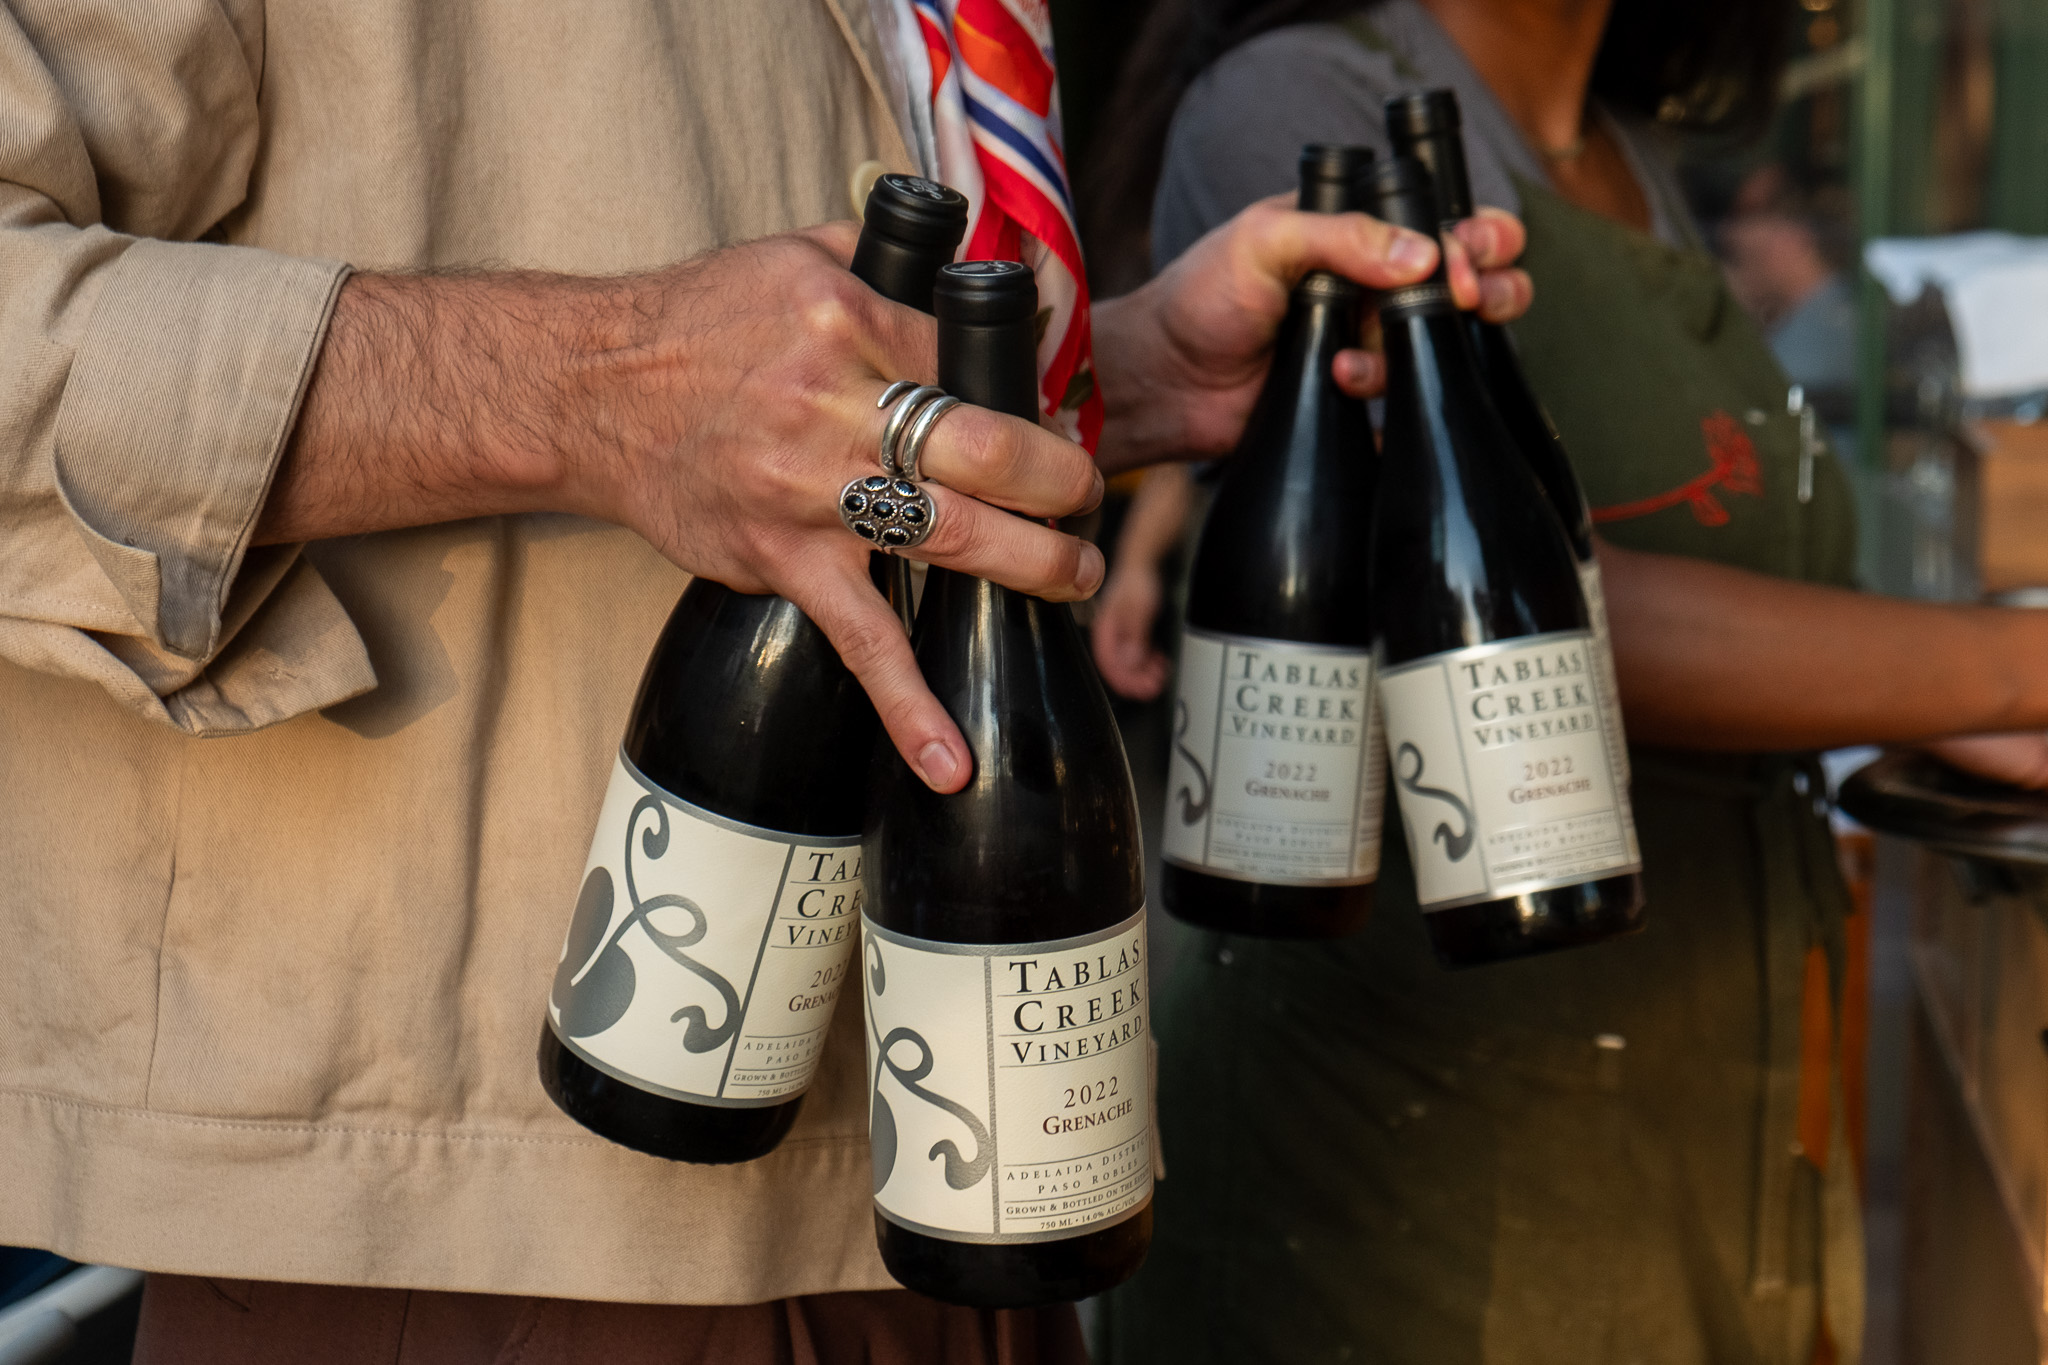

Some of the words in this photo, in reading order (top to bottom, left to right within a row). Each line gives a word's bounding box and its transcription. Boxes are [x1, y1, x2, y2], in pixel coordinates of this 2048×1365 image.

[1237, 652, 1360, 688] TABLAS
[1461, 651, 1582, 689] TABLAS
[1236, 685, 1355, 720] CREEK
[1471, 683, 1588, 721] CREEK
[1233, 716, 1356, 744] VINEYARD
[1474, 714, 1594, 747] VINEYARD
[1264, 761, 1318, 782] 2022
[1524, 756, 1574, 781] 2022
[1245, 780, 1330, 802] GRENACHE
[1508, 778, 1591, 804] GRENACHE
[1009, 939, 1140, 993] TABLAS
[1014, 979, 1141, 1032] CREEK
[744, 1038, 811, 1051] ADELAIDA
[1011, 1015, 1142, 1063] VINEYARD
[766, 1053, 799, 1065] PASO
[733, 1073, 768, 1082] GROWN
[1064, 1076, 1118, 1109] 2022
[1042, 1098, 1133, 1135] GRENACHE
[1007, 1162, 1093, 1181] ADELAIDA
[1102, 1133, 1149, 1166] DISTRICT
[1038, 1180, 1081, 1194] PASO
[1092, 1158, 1138, 1185] ROBLES
[1006, 1205, 1046, 1215] GROWN
[1062, 1194, 1104, 1210] BOTTLED
[1106, 1188, 1118, 1198] ON
[1120, 1180, 1132, 1192] THE
[1040, 1221, 1056, 1230] 750
[1059, 1217, 1073, 1228] ML
[1082, 1211, 1104, 1223] 14.0%
